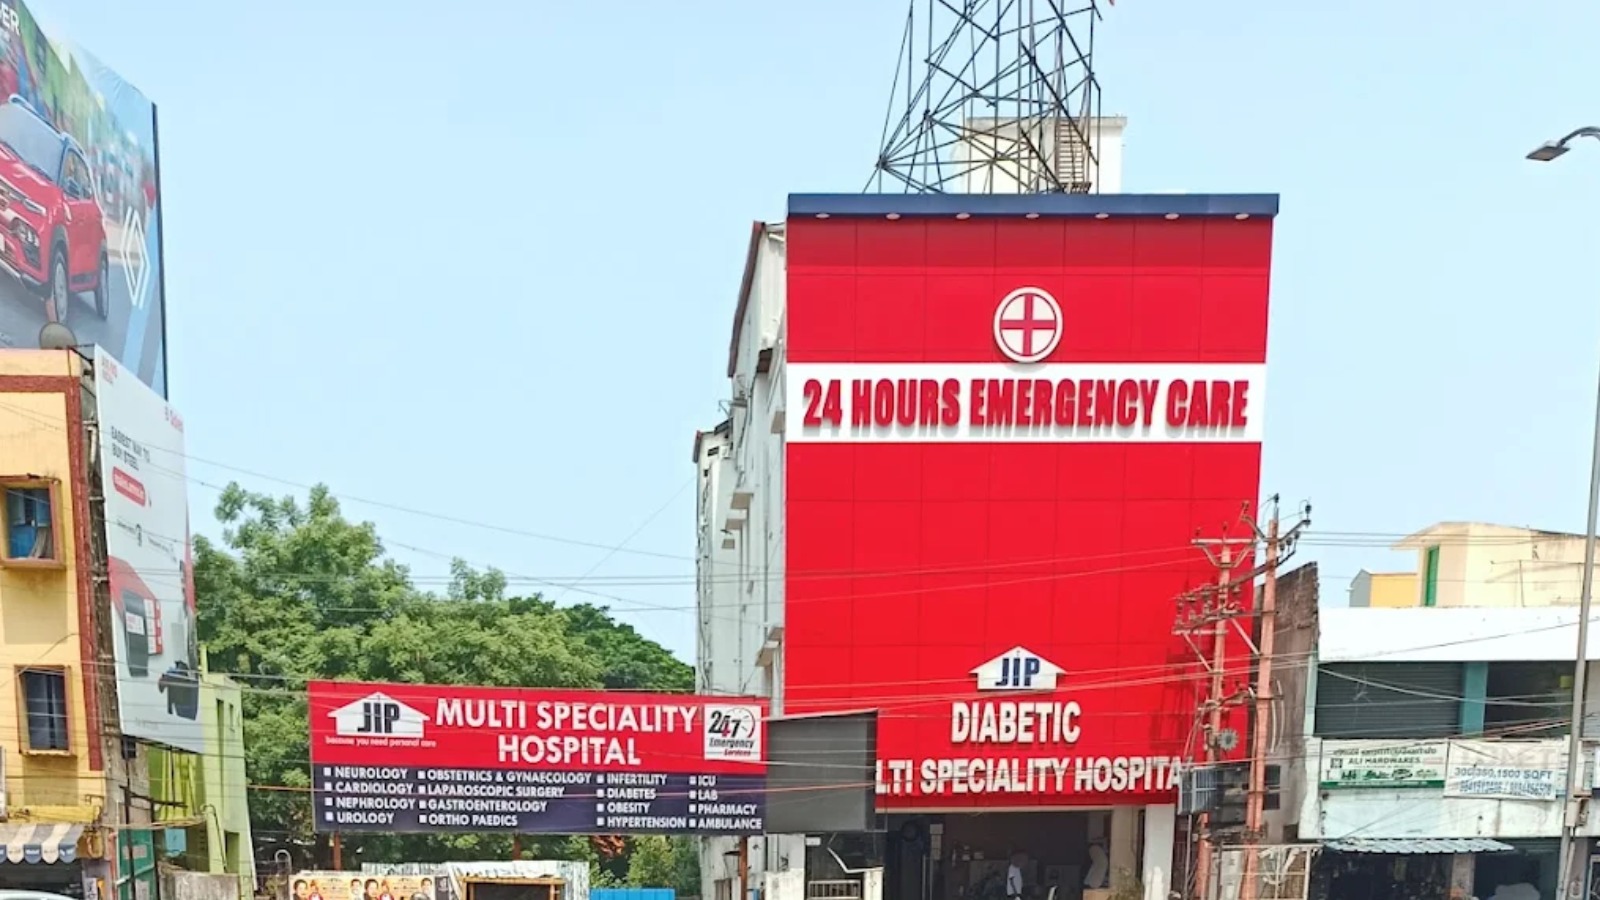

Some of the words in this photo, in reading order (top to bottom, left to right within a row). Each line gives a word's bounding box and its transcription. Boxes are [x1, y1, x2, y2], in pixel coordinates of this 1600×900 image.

[0, 1, 21, 36] ER
[802, 378, 843, 427] 24
[851, 378, 961, 427] HOURS
[969, 378, 1160, 427] EMERGENCY
[1165, 379, 1249, 427] CARE
[995, 657, 1040, 687] JIP
[357, 702, 400, 734] JIP
[436, 697, 527, 729] MULTI
[536, 701, 698, 733] SPECIALITY
[951, 700, 1081, 743] DIABETIC
[325, 735, 355, 745] because
[356, 738, 369, 747] you
[370, 737, 388, 746] need
[389, 738, 420, 747] personal
[709, 738, 754, 749] Emergency
[498, 735, 641, 765] HOSPITAL
[335, 767, 408, 780] NEUROLOGY
[427, 770, 492, 783] OBSTETRICS
[496, 771, 505, 783] &
[507, 772, 592, 785] GYNAECOLOGY
[607, 773, 667, 786] INFERTILITY
[875, 759, 913, 794] LTI
[920, 758, 1069, 794] SPECIALITY
[1074, 756, 1181, 793] HOSPITA
[1523, 769, 1554, 780] SQFT
[698, 775, 716, 786] ICU
[335, 782, 413, 795] CARDIOLOGY
[428, 784, 515, 797] LAPAROSCOPIC
[516, 786, 565, 798] SURGERY
[607, 788, 656, 799] DIABETES
[698, 789, 718, 800] LAB
[335, 797, 416, 810] NEPHROLOGY
[428, 799, 548, 812] GASTROENTEROLOGY
[607, 802, 651, 813] OBESITY
[698, 804, 757, 815] PHARMACY
[336, 811, 395, 824] UROLOGY
[428, 814, 471, 826] ORTHO
[473, 815, 518, 827] PAEDICS
[607, 816, 686, 828] HYPERTENSION
[698, 818, 762, 829] AMBULANCE
